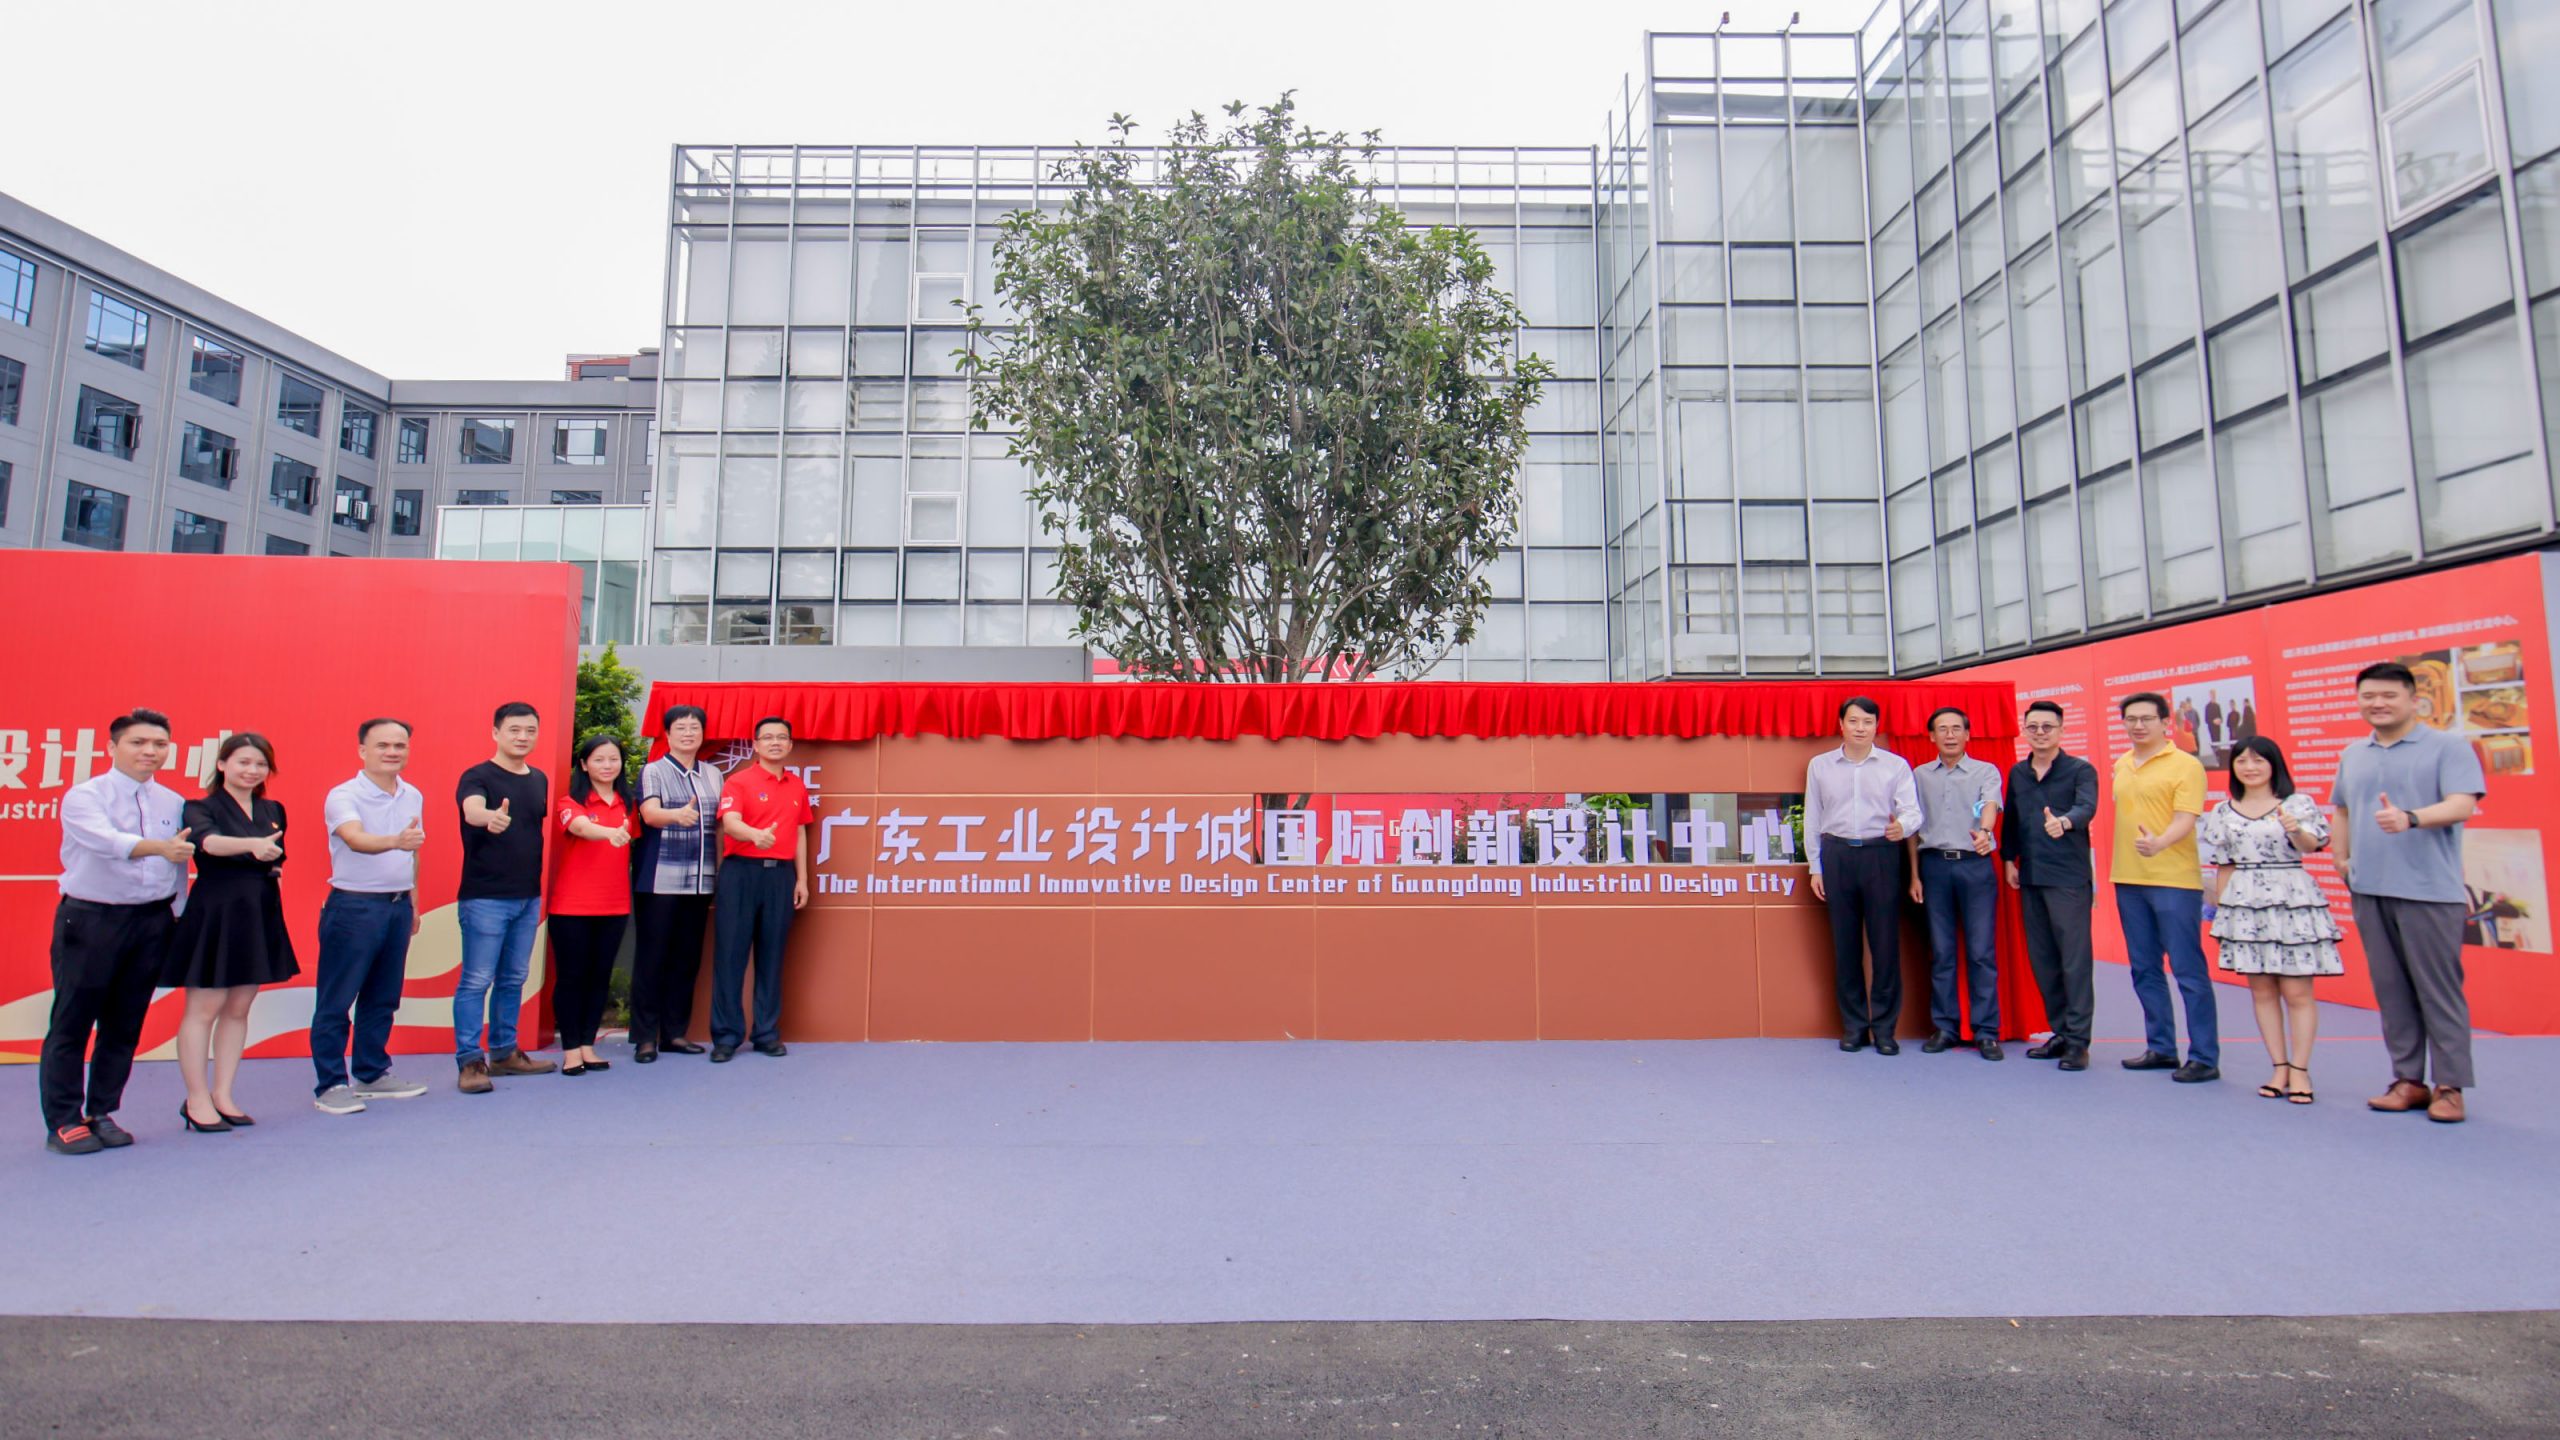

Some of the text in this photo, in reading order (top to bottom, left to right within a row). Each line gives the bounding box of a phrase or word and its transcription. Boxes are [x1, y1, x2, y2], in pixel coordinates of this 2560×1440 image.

[817, 873, 1795, 897] The International Innovative Design Center of Guangdong Industrial Design City
